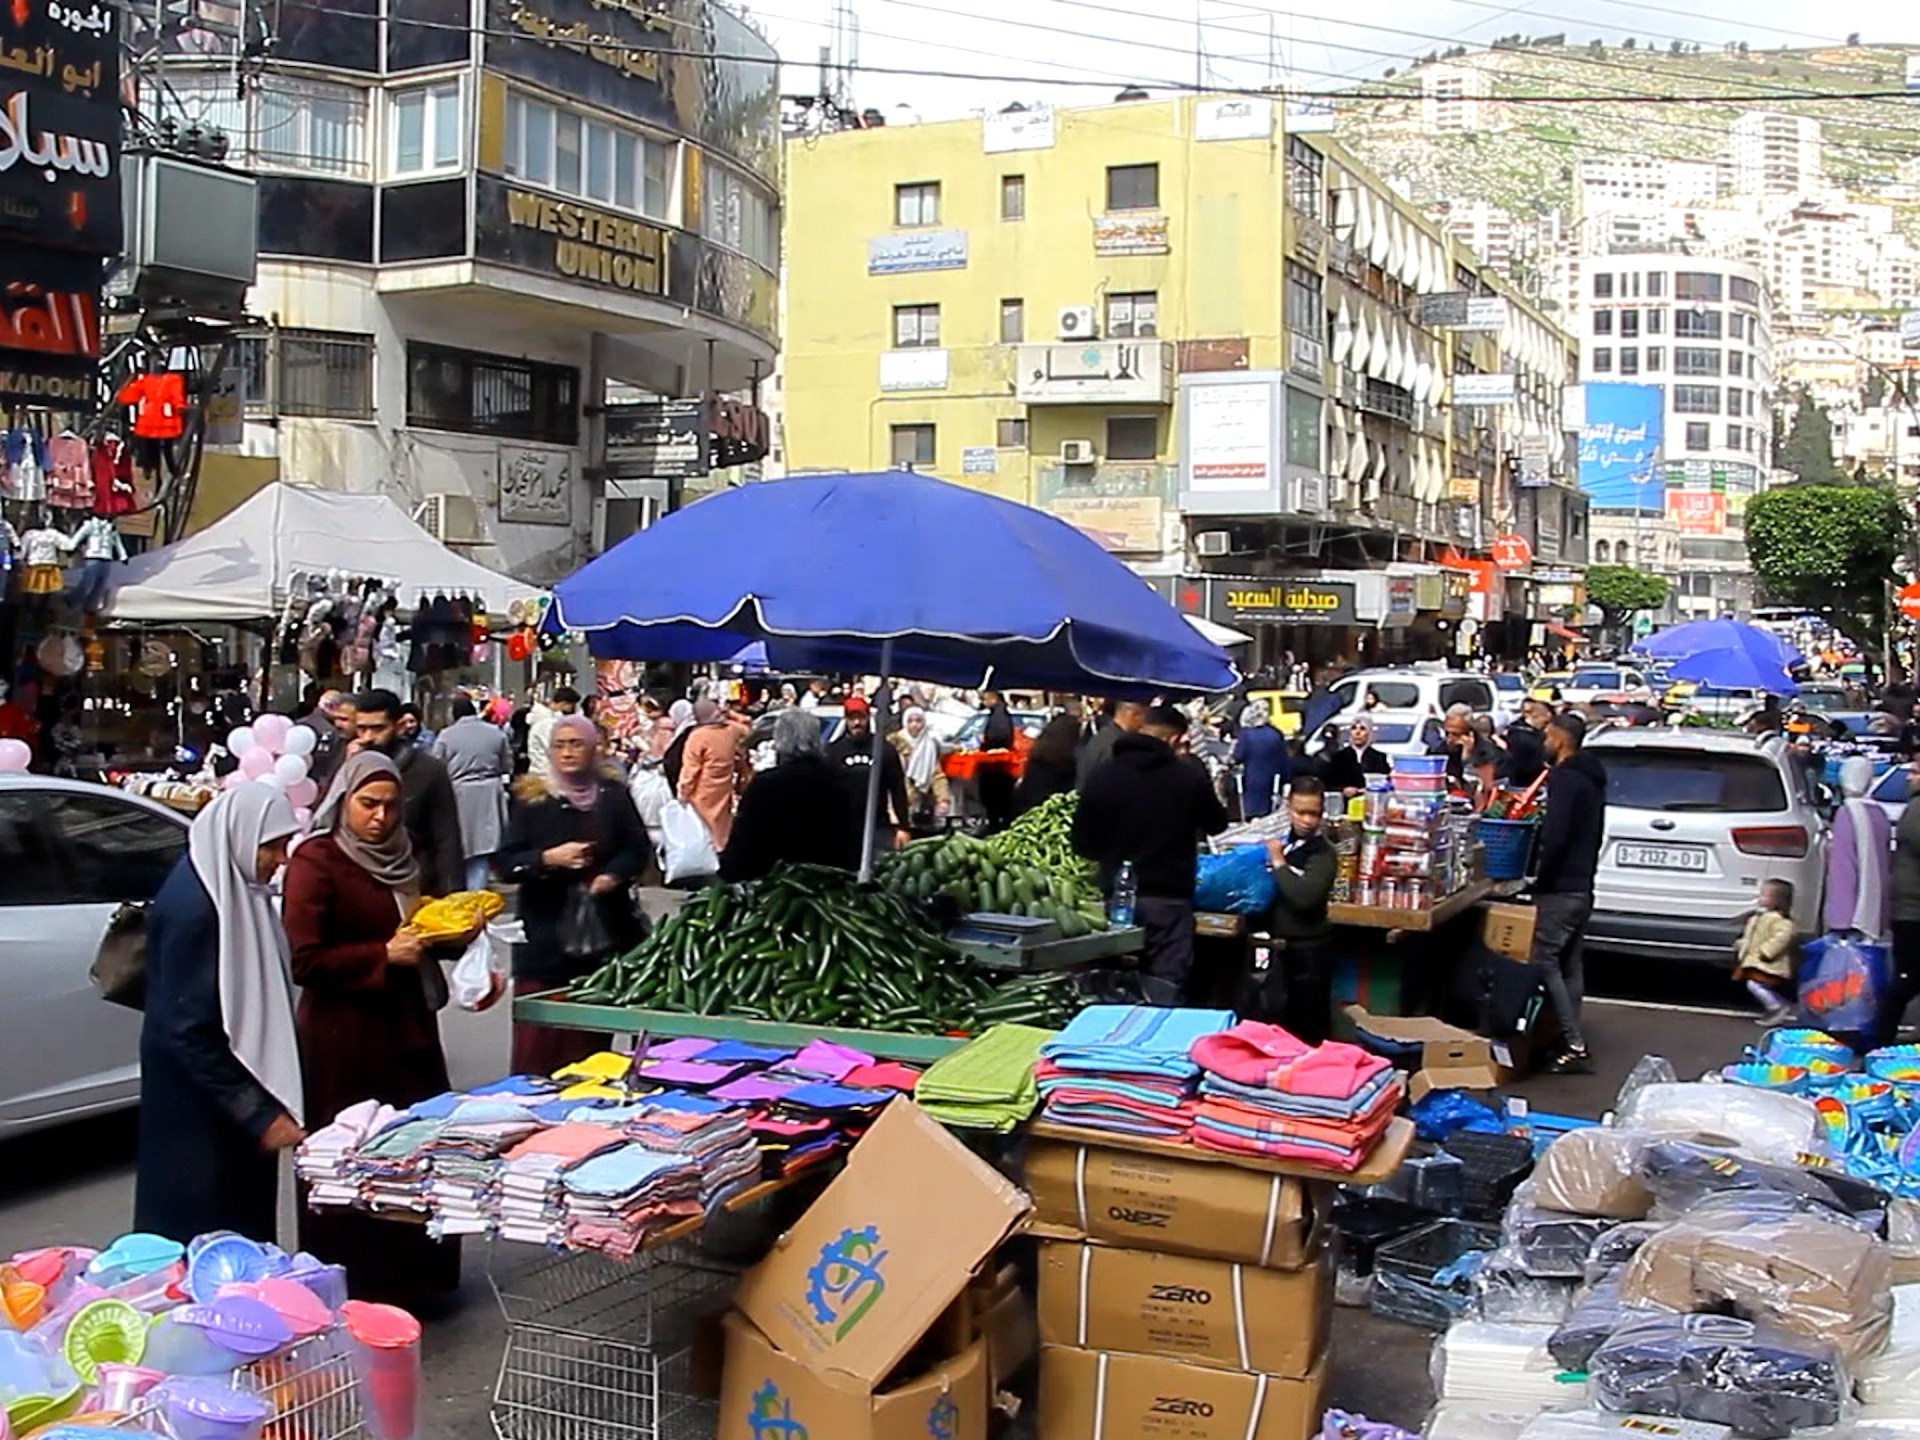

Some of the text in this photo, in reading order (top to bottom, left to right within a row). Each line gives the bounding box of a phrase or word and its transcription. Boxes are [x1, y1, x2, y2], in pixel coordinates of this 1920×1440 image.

[507, 189, 655, 258] WESTERN
[555, 239, 655, 293] UNION
[1226, 587, 1340, 614] صيدلية السعيد
[1107, 1205, 1171, 1228] ZERO
[1147, 1284, 1211, 1305] ZERO
[1150, 1397, 1214, 1418] ZERO
